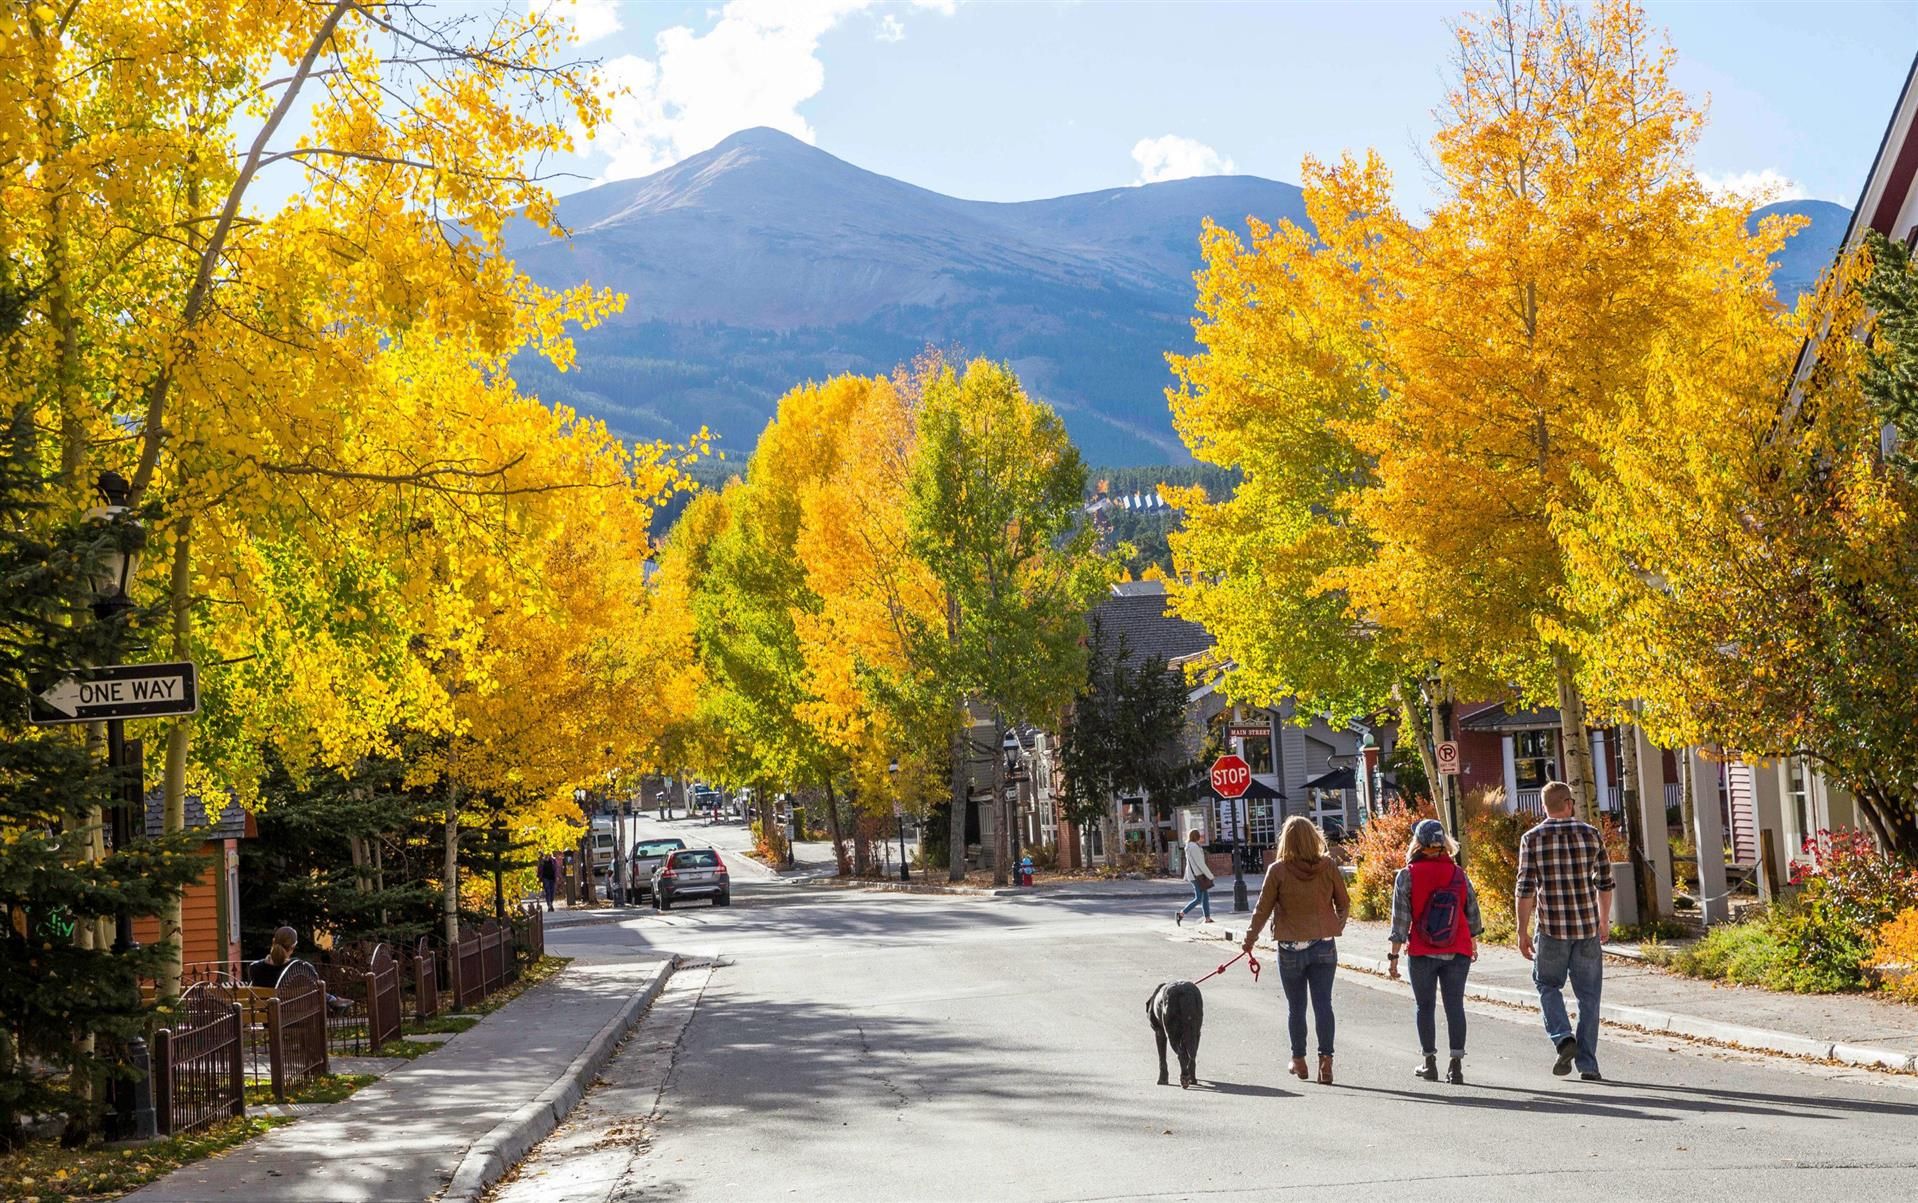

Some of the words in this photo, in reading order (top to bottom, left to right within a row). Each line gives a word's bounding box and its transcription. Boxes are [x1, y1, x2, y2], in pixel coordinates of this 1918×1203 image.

[79, 683, 123, 703] ONE
[132, 679, 176, 700] WAY
[1213, 767, 1247, 786] STOP
